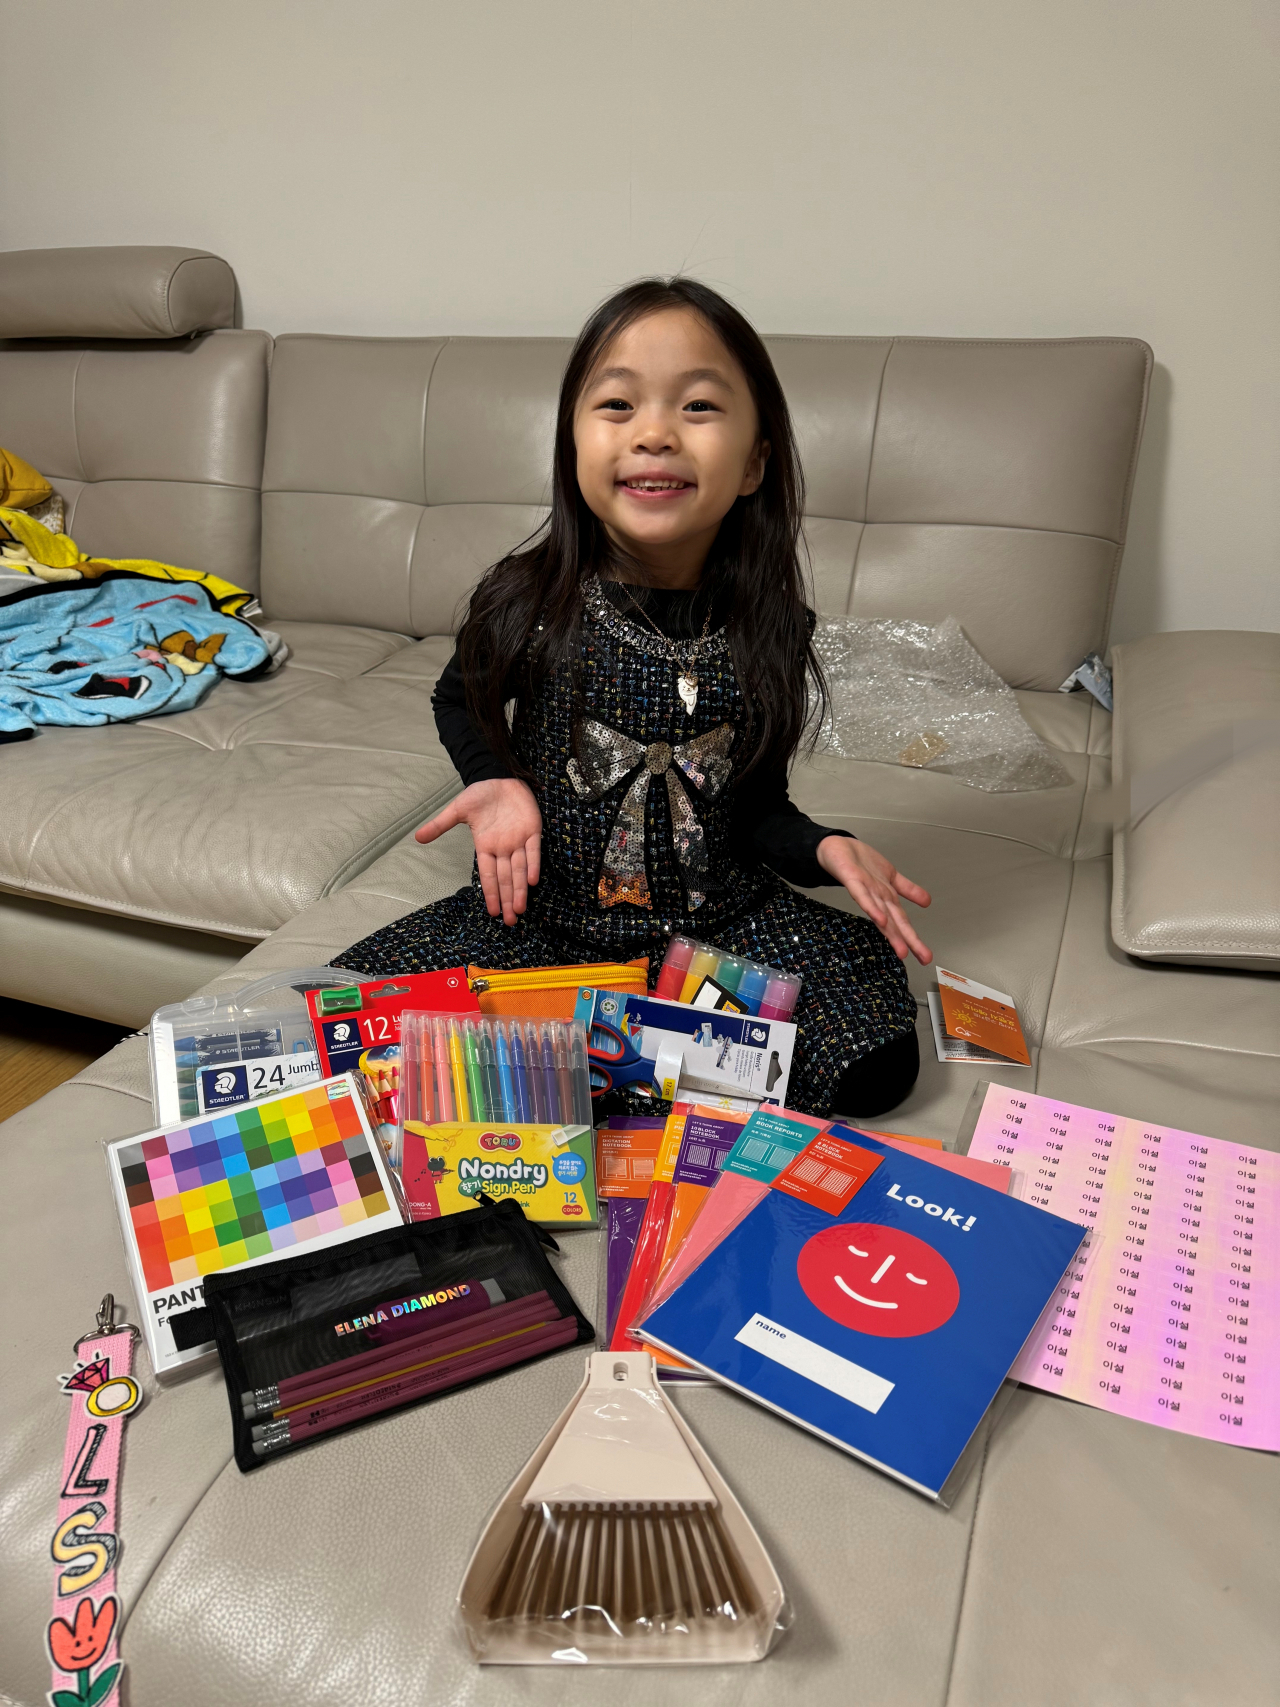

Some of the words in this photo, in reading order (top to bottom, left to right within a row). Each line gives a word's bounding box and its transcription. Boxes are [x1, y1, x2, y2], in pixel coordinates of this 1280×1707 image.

[363, 1016, 392, 1041] 12
[330, 1041, 359, 1050] STAEDTLER
[252, 1064, 286, 1090] 24
[288, 1061, 320, 1075] Jumb
[209, 1094, 245, 1105] STAEDTLER
[1011, 1100, 1026, 1109] 이설
[1006, 1114, 1022, 1124] 이설
[1054, 1113, 1070, 1122] 이설
[697, 1126, 716, 1134] BLOCK
[756, 1121, 773, 1130] BOOK
[774, 1125, 803, 1138] REPORTS
[1050, 1127, 1066, 1136] 이설
[1098, 1124, 1115, 1132] 이설
[690, 1130, 720, 1139] NOTEBOOK
[1002, 1129, 1018, 1139] 이설
[1144, 1134, 1161, 1143] 이설
[485, 1137, 518, 1147] TORU
[1046, 1142, 1063, 1151] 이설
[1095, 1138, 1112, 1147] 이설
[814, 1144, 843, 1159] NOTEBOOK
[823, 1142, 840, 1153] BLOCK
[998, 1145, 1014, 1154] 이설
[1191, 1145, 1208, 1154] 이설
[1092, 1153, 1109, 1161] 이설
[1141, 1149, 1158, 1158] 이설
[1043, 1156, 1059, 1164] 이설
[1189, 1160, 1206, 1169] 이설
[1239, 1156, 1257, 1165] 이설
[460, 1158, 546, 1186] Nondry
[1089, 1167, 1106, 1175] 이설
[1139, 1163, 1156, 1172] 이설
[1039, 1169, 1056, 1178] 이설
[1187, 1174, 1204, 1183] 이설
[1238, 1171, 1256, 1179] 이설
[460, 1180, 482, 1193] 향기
[1035, 1182, 1052, 1191] 이설
[1086, 1180, 1103, 1189] 이설
[1136, 1178, 1154, 1186] 이설
[482, 1182, 510, 1195] Sign
[511, 1182, 536, 1194] Pen
[1185, 1188, 1203, 1197] 이설
[1237, 1185, 1255, 1194] 이설
[564, 1192, 577, 1203] 12
[1031, 1196, 1048, 1205] 이설
[1082, 1194, 1100, 1203] 이설
[1134, 1192, 1152, 1200] 이설
[886, 1183, 977, 1232] Look!
[1183, 1203, 1201, 1212] 이설
[1236, 1200, 1254, 1209] 이설
[1079, 1209, 1097, 1218] 이설
[1131, 1206, 1149, 1215] 이설
[1182, 1218, 1200, 1227] 이설
[1235, 1215, 1253, 1224] 이설
[1129, 1221, 1147, 1230] 이설
[1180, 1233, 1198, 1243] 이설
[1233, 1230, 1252, 1240] 이설
[1126, 1236, 1144, 1246] 이설
[1178, 1249, 1196, 1259] 이설
[1232, 1246, 1251, 1256] 이설
[1123, 1252, 1142, 1262] 이설
[1176, 1265, 1195, 1276] 이설
[1231, 1263, 1251, 1273] 이설
[1066, 1272, 1083, 1282] 이설
[1120, 1268, 1139, 1279] 이설
[1173, 1283, 1193, 1294] 이설
[1230, 1280, 1250, 1290] 이설
[1061, 1289, 1080, 1299] 이설
[1117, 1285, 1136, 1297] 이설
[153, 1284, 204, 1314] PANT
[1228, 1297, 1249, 1307] 이설
[334, 1310, 389, 1337] ELENA
[391, 1284, 471, 1318] DIAMOND
[1114, 1303, 1133, 1315] 이설
[1171, 1300, 1191, 1312] 이설
[1056, 1307, 1076, 1318] 이설
[1169, 1319, 1189, 1330] 이설
[1227, 1315, 1248, 1326] 이설
[755, 1320, 787, 1339] name
[1052, 1325, 1072, 1337] 이설
[1110, 1322, 1130, 1334] 이설
[1226, 1333, 1247, 1344] 이설
[1107, 1341, 1127, 1353] 이설
[1166, 1338, 1187, 1350] 이설
[1048, 1344, 1067, 1357] 이설
[1164, 1357, 1184, 1369] 이설
[1224, 1353, 1246, 1364] 이설
[1043, 1364, 1063, 1376] 이설
[1103, 1361, 1124, 1373] 이설
[1223, 1372, 1245, 1384] 이설
[1099, 1381, 1120, 1394] 이설
[1161, 1377, 1182, 1390] 이설
[1221, 1393, 1243, 1404] 이설
[1158, 1398, 1180, 1411] 이설
[1220, 1414, 1242, 1426] 이설
[61, 1424, 109, 1498] L
[52, 1502, 118, 1596] S
